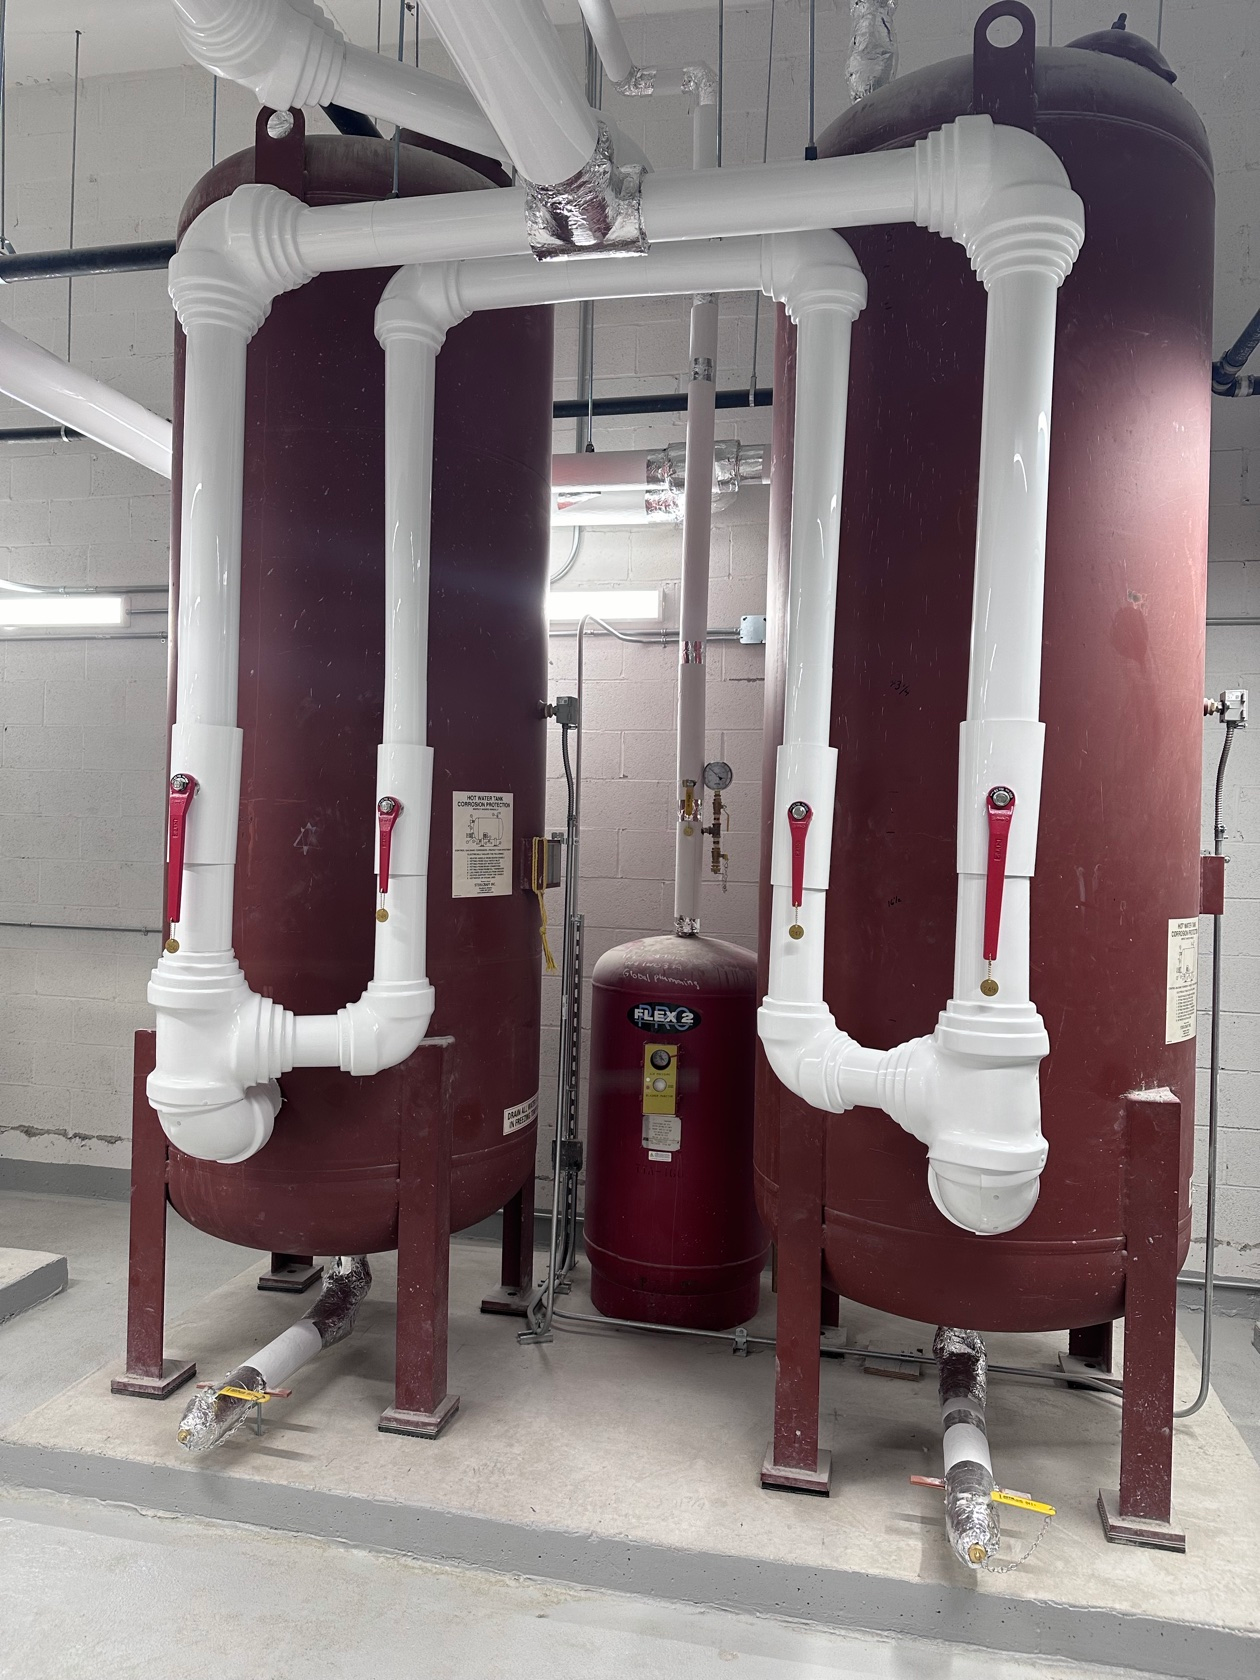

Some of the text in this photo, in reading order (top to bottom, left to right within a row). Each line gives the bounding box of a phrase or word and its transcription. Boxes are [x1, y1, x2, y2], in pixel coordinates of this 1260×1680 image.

[623, 968, 651, 983] Global
[634, 1008, 694, 1023] FLEX 2
[639, 1004, 690, 1031] PRO
[507, 1108, 521, 1120] DRAIN
[509, 1120, 515, 1129] IN
